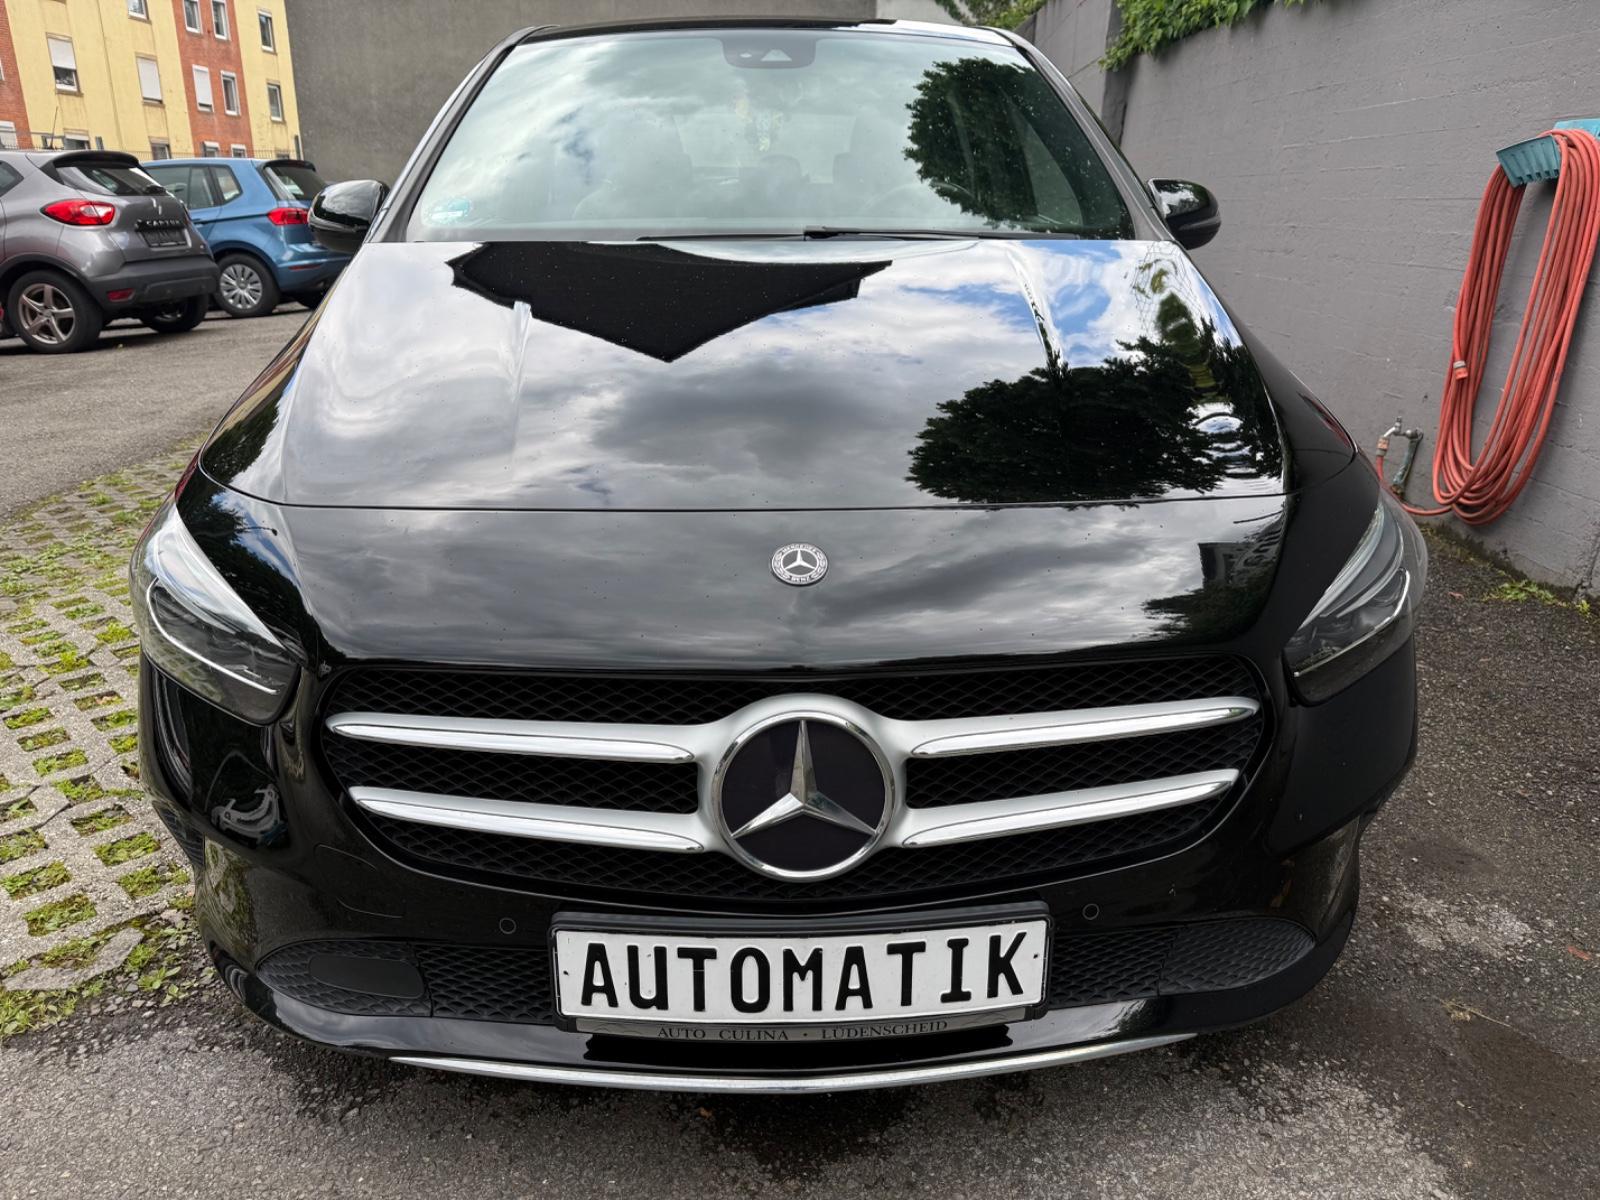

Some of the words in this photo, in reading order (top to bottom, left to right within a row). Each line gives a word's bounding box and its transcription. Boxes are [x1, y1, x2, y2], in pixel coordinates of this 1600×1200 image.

[580, 931, 1027, 1014] AUTOMATIK
[657, 1027, 706, 1039] AUTO
[718, 1029, 789, 1041] CULINA
[821, 1020, 949, 1040] LÜDENSCHEID
